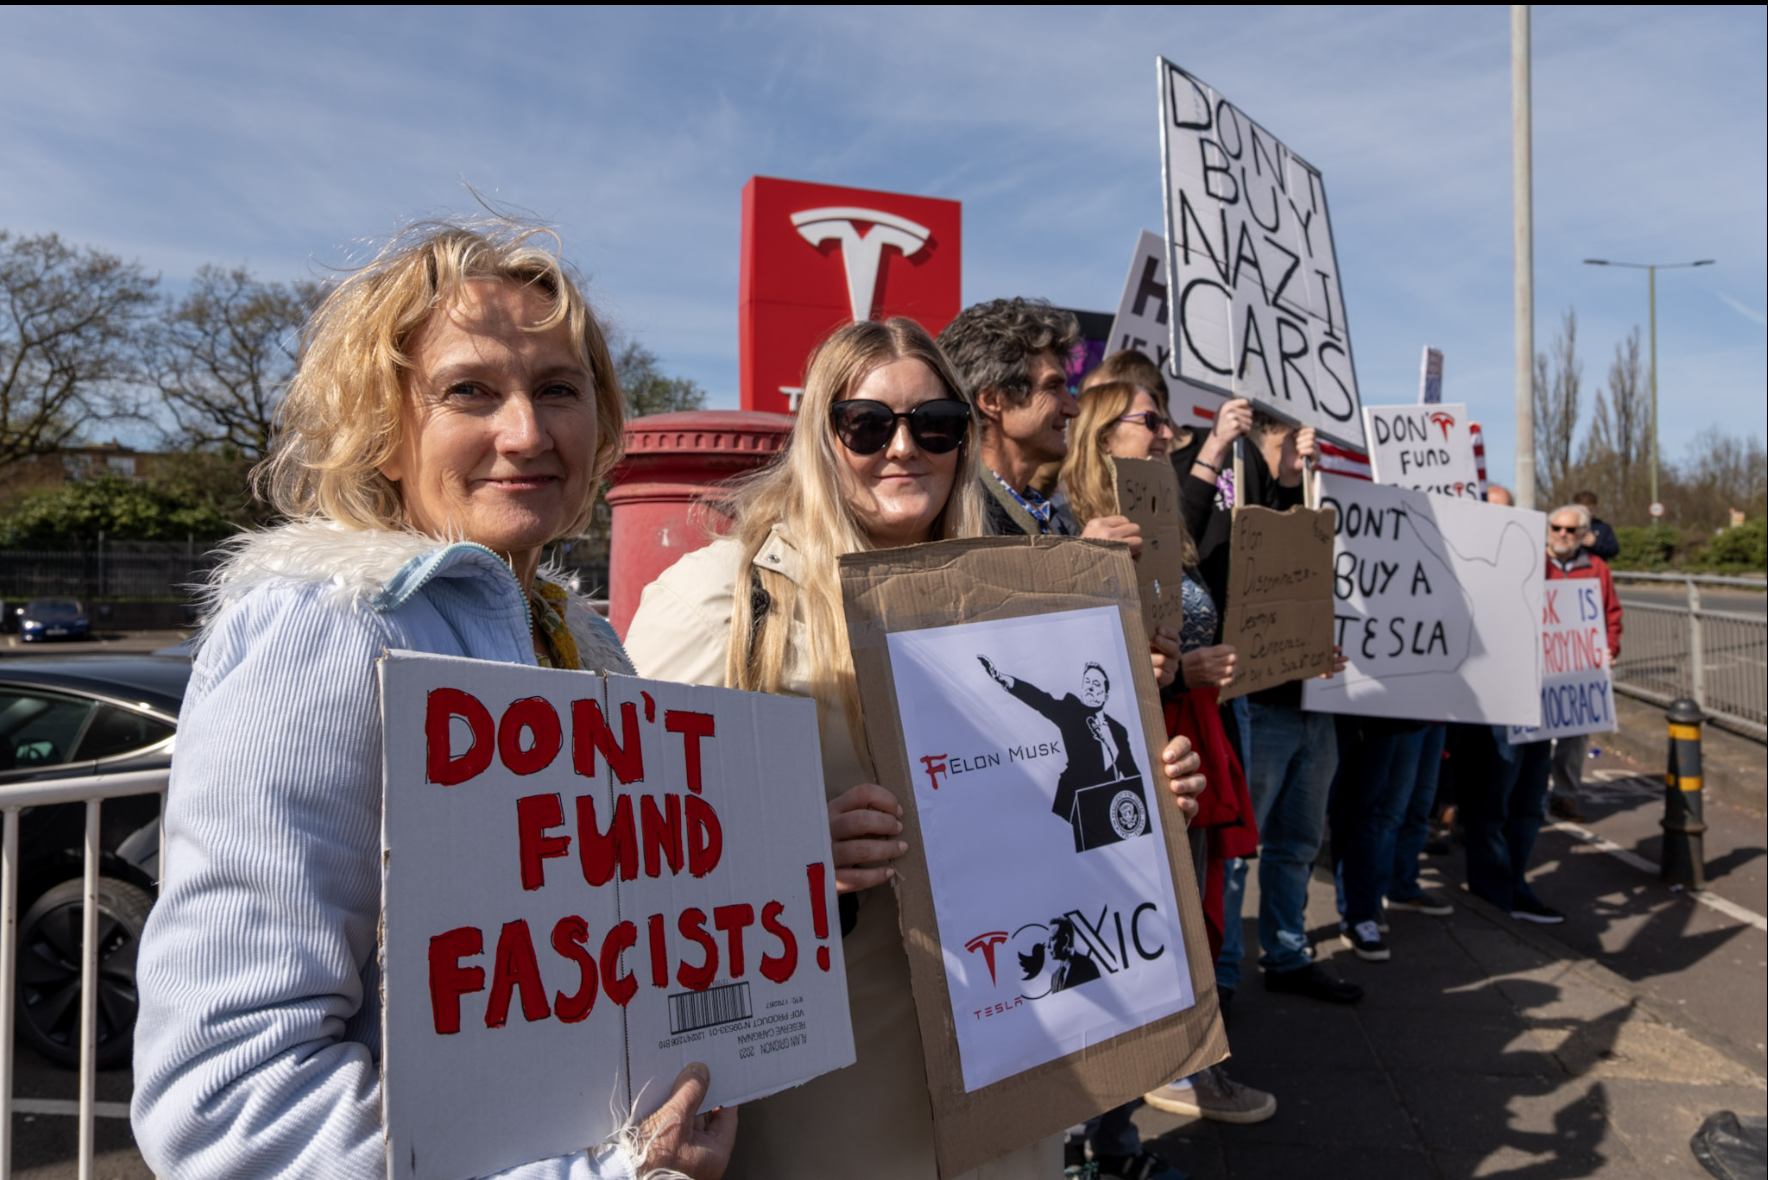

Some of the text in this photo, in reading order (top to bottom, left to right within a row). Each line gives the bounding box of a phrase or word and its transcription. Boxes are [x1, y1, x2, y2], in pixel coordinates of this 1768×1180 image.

[1169, 67, 1322, 214] DON'T
[1200, 137, 1314, 258] BUY
[1179, 189, 1343, 343] NAZI
[1180, 279, 1353, 422] CARS
[1373, 411, 1455, 445] DON'T
[1334, 551, 1433, 601] BUY A
[1578, 588, 1599, 622] IS
[1333, 615, 1448, 660] TESLA
[1542, 626, 1602, 675] ROYING
[425, 687, 715, 794] DON'T
[920, 740, 1061, 790] FELON MUSK
[517, 792, 723, 891] FUND
[429, 862, 831, 1035] FASCISTS!
[737, 1021, 806, 1045] RESERVE CARIGNAN
[753, 1012, 790, 1027] PRODUCT
[790, 1009, 805, 1020] VDF
[974, 997, 1024, 1020] TESLA
[790, 1033, 807, 1049] ALAIN
